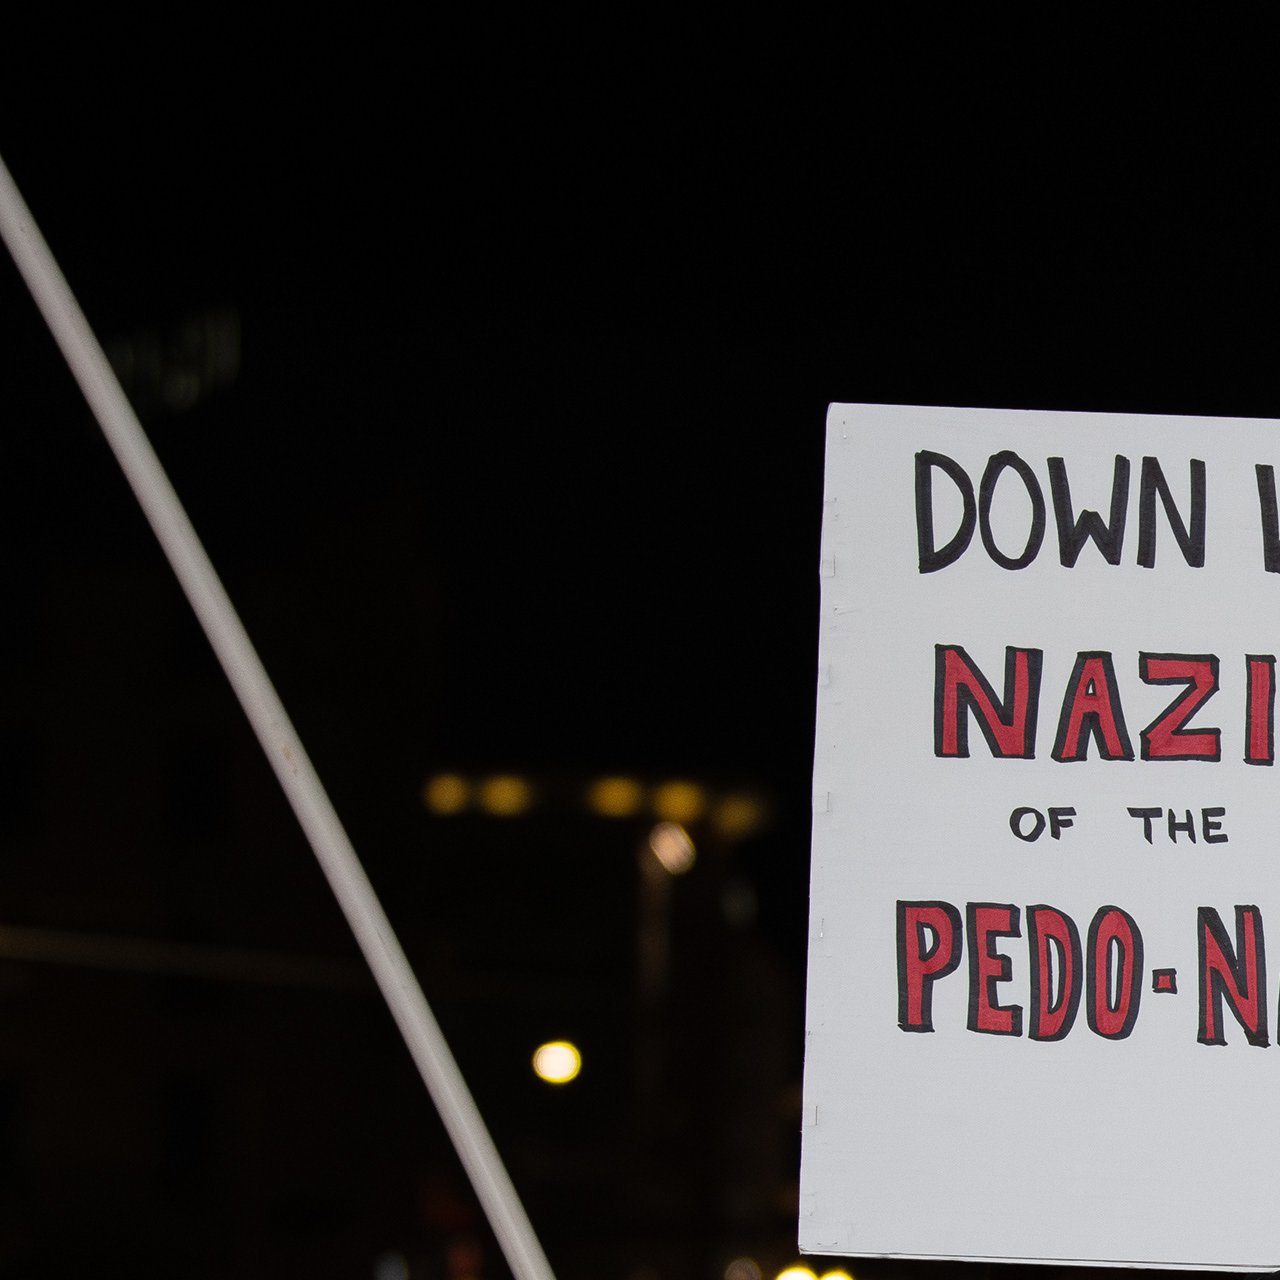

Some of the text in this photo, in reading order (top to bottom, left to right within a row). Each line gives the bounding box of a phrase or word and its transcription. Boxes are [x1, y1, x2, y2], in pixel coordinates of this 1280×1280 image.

[915, 450, 1206, 574] DOWN
[934, 644, 1276, 766] NAZI
[1010, 807, 1076, 842] OF
[1127, 807, 1228, 844] THE
